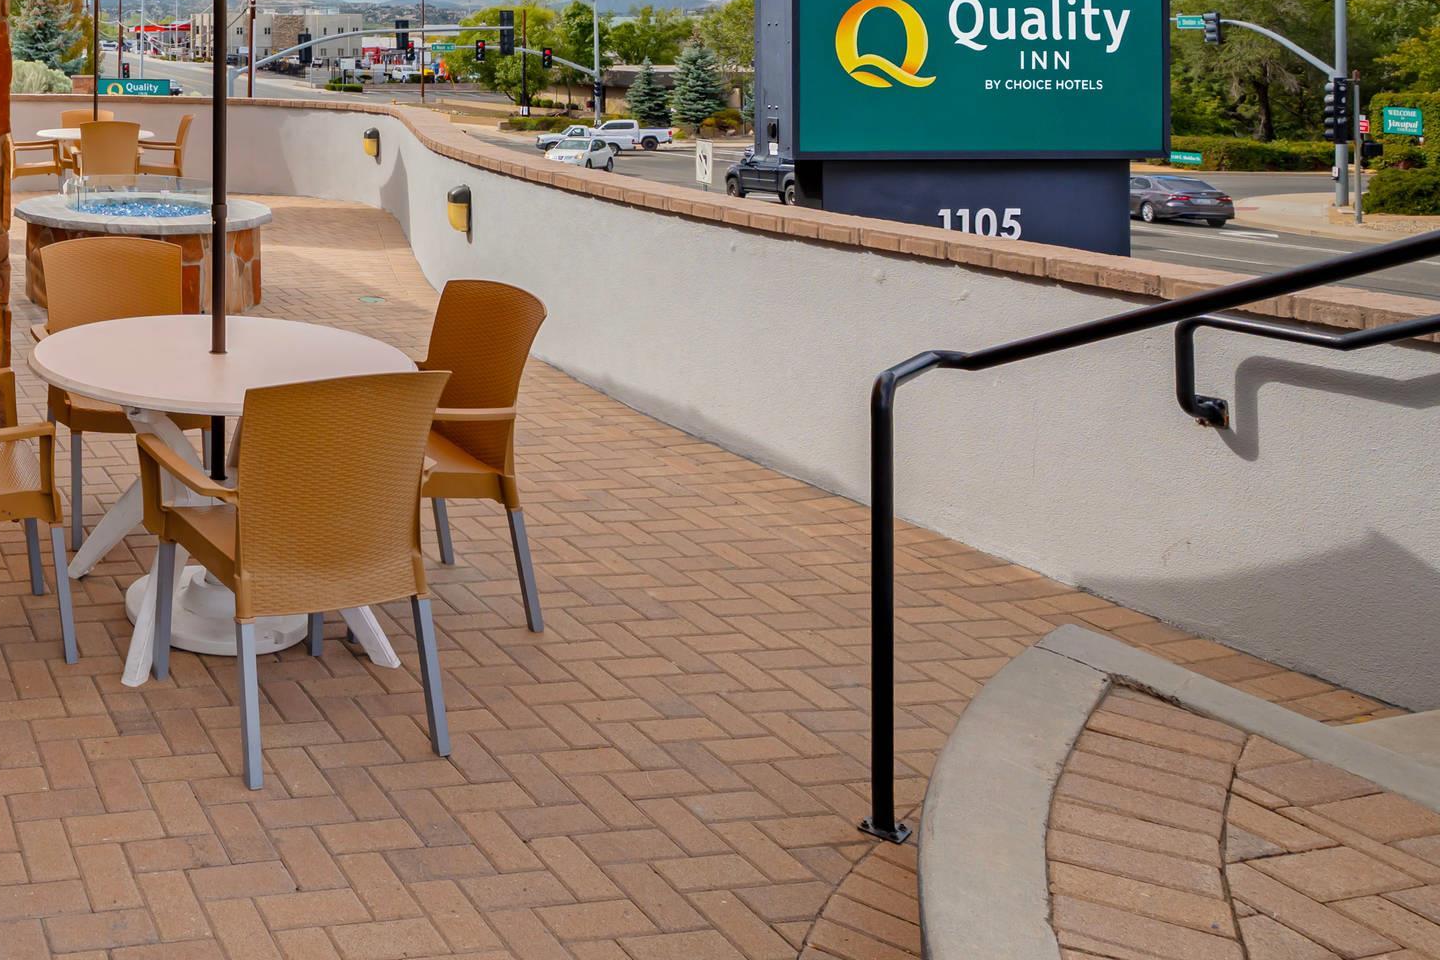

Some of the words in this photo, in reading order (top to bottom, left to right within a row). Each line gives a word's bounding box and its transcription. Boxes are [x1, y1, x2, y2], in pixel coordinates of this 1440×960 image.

[1020, 50, 1070, 70] INN
[125, 82, 159, 93] Quality
[984, 79, 1000, 90] BY
[1005, 79, 1052, 91] CHOICE
[1055, 79, 1104, 91] HOTELS
[937, 207, 1022, 241] 1105
